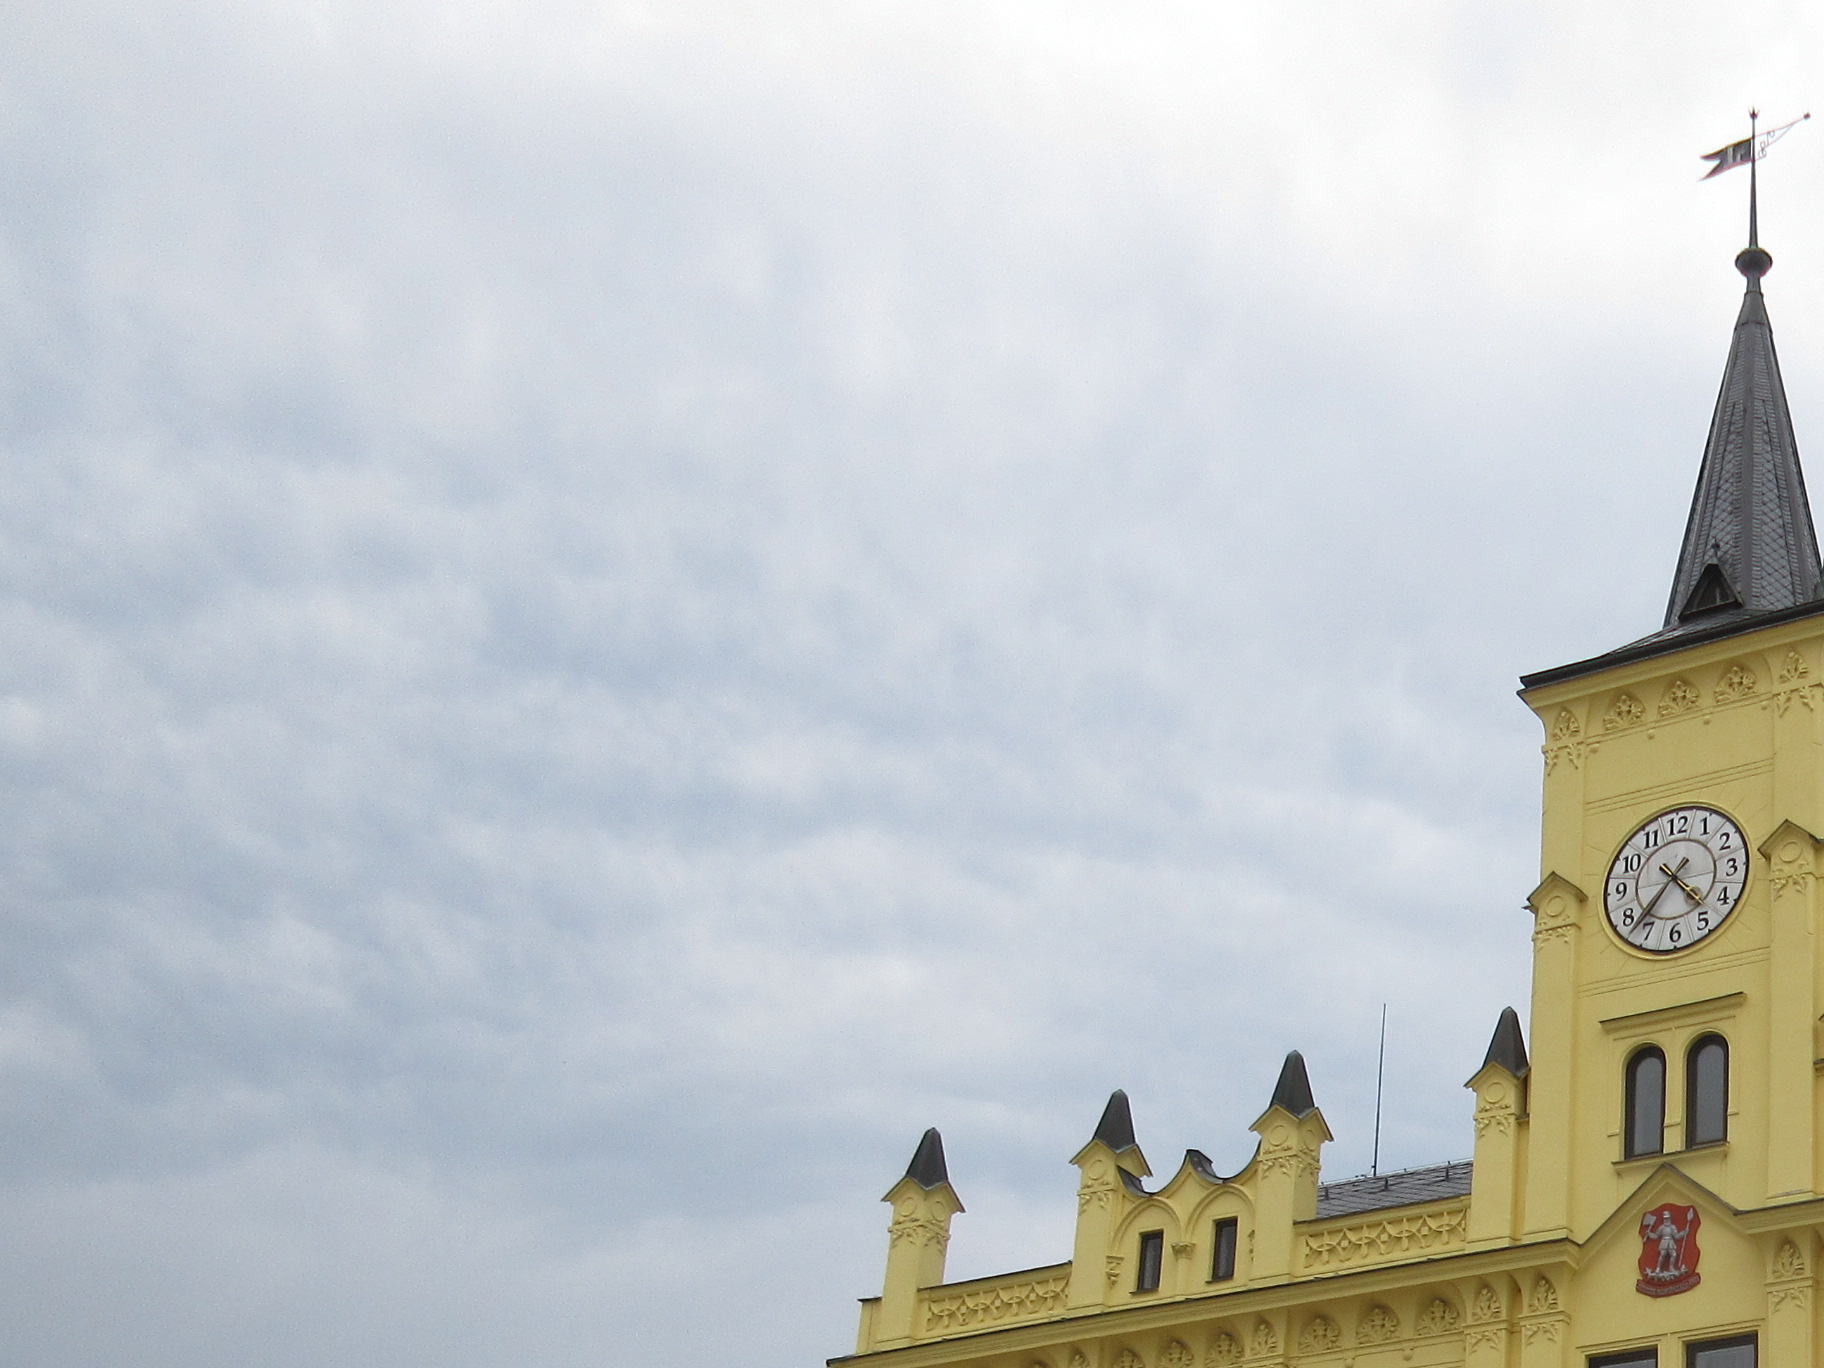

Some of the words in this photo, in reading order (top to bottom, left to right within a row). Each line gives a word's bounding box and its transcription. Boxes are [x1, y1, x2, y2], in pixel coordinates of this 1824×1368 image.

[1666, 815, 1689, 837] 12
[1700, 816, 1710, 837] 1
[1643, 829, 1660, 850] 11
[1719, 832, 1731, 851] 2
[1622, 853, 1642, 875] 10
[1725, 857, 1738, 877] 3
[1615, 881, 1628, 901] 9
[1716, 886, 1730, 907] 4
[1622, 907, 1635, 927] 8
[1696, 910, 1709, 931] 5
[1642, 920, 1655, 942] 7
[1669, 922, 1682, 943] 6
